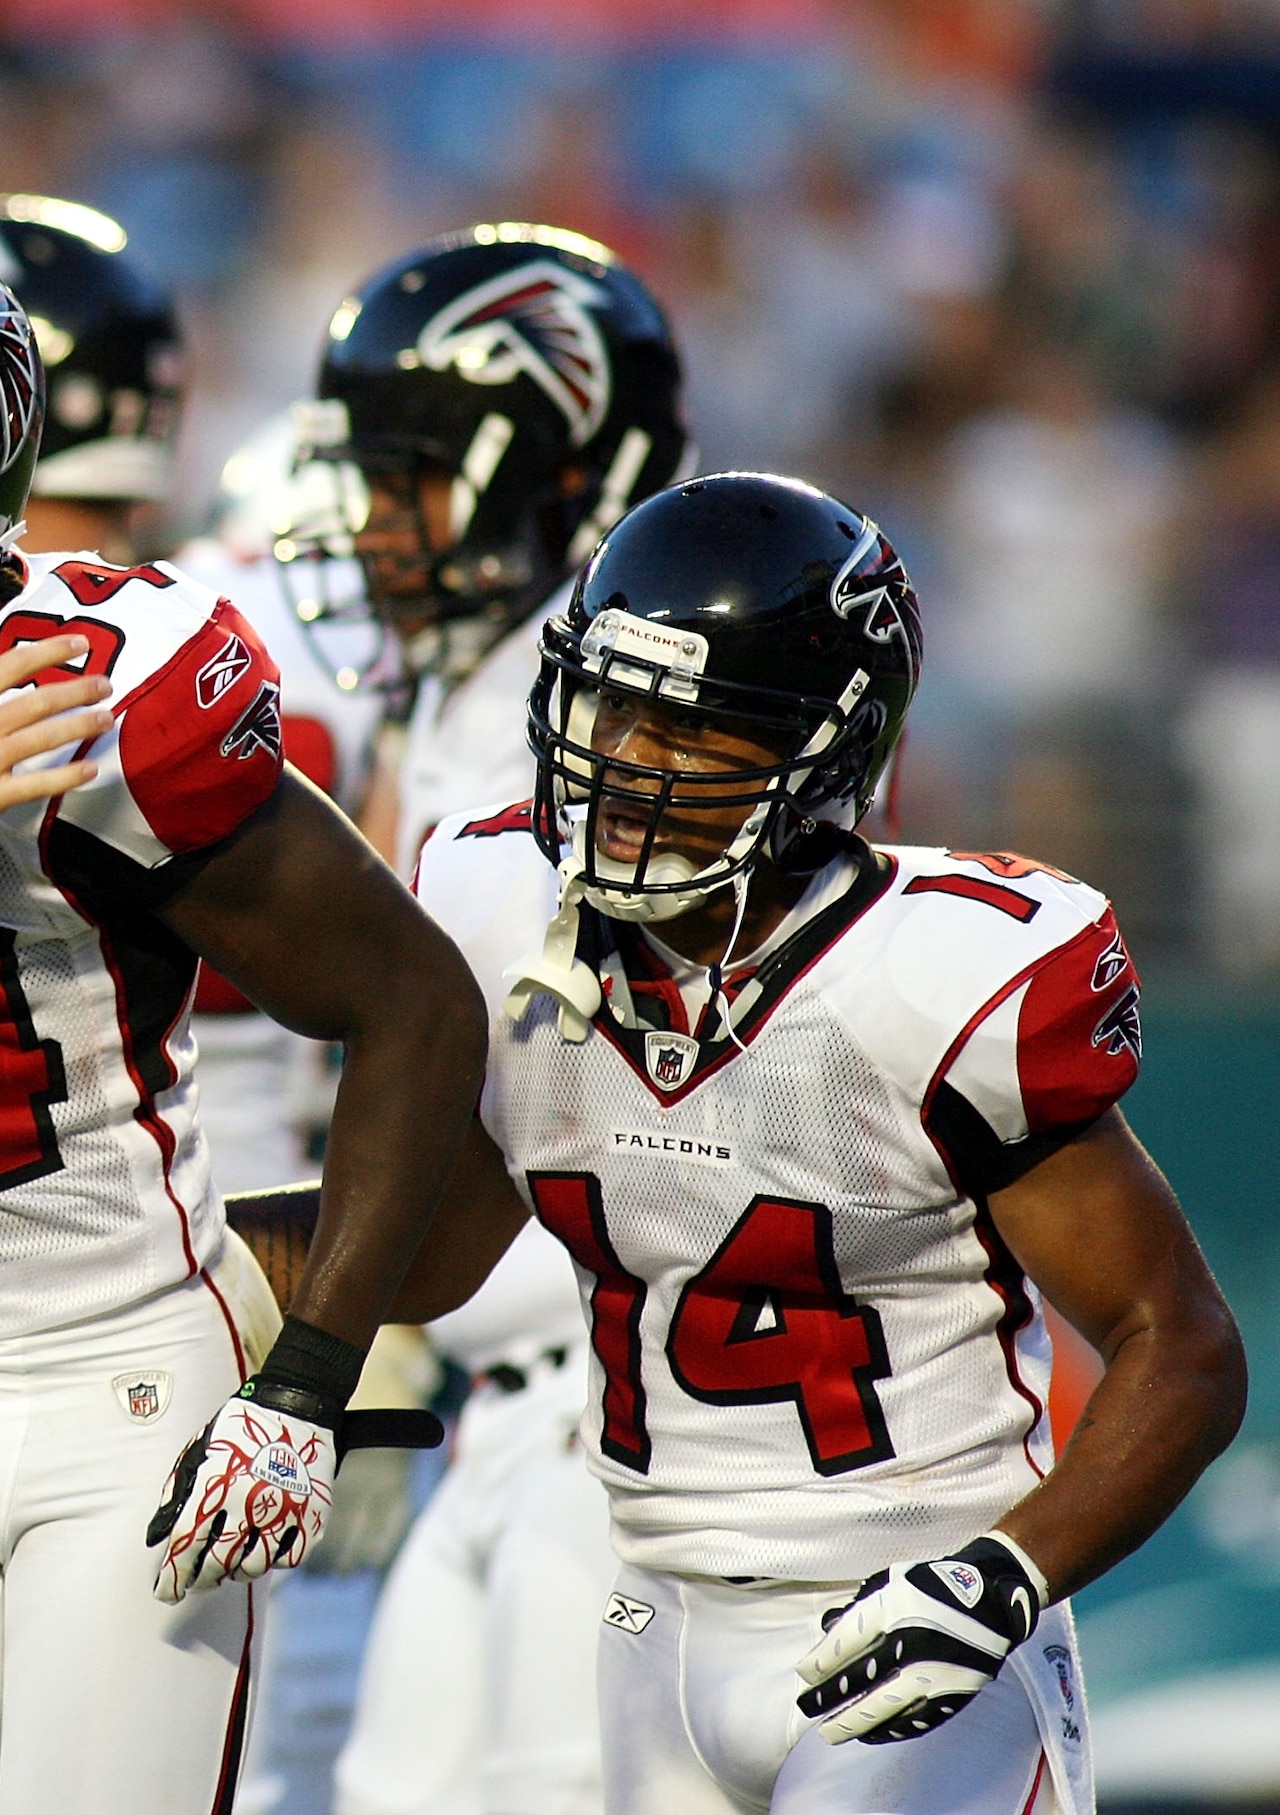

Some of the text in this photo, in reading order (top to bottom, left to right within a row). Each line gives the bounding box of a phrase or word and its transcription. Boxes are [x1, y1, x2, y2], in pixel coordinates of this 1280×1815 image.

[620, 624, 681, 649] FALCONS
[614, 1132, 732, 1160] FALCONS
[525, 1169, 897, 1478] 14
[130, 1396, 159, 1415] NFL
[269, 1448, 298, 1471] NFL
[253, 1466, 309, 1493] EQUIPMENT
